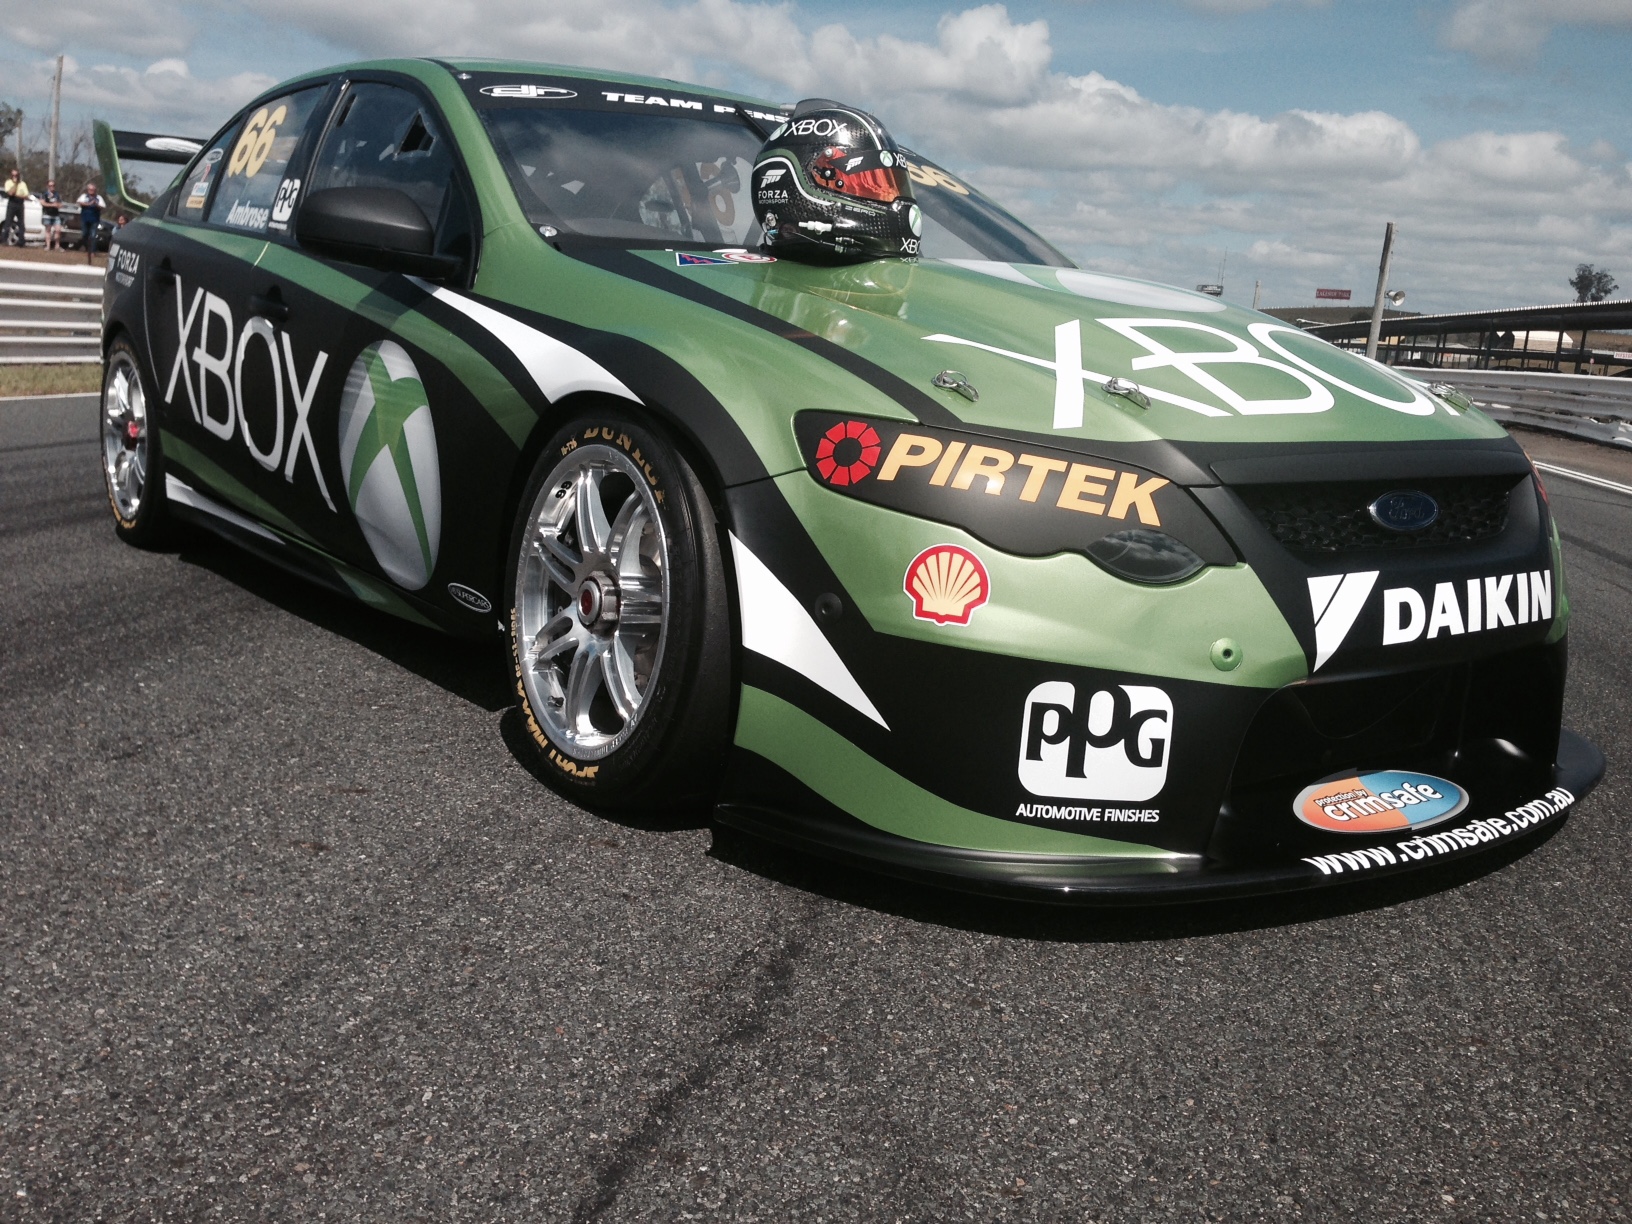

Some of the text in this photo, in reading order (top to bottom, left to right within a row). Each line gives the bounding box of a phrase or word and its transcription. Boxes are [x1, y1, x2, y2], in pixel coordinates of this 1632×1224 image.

[601, 91, 703, 110] TEAM
[713, 104, 791, 124] PENS
[227, 105, 288, 178] 66
[784, 118, 848, 137] XBOX
[893, 152, 907, 169] XB
[758, 190, 789, 199] FORZA
[226, 199, 270, 230] Ambrose
[117, 248, 140, 275] FORZA
[164, 274, 338, 513] XBOX
[555, 480, 573, 499] 66
[876, 433, 1171, 527] PIRTEK
[1382, 569, 1552, 646] DAIKIN
[1314, 788, 1369, 808] protection by
[1322, 780, 1444, 822] crimsafe
[1015, 803, 1160, 823] AUTOMOTIVE FINISHES
